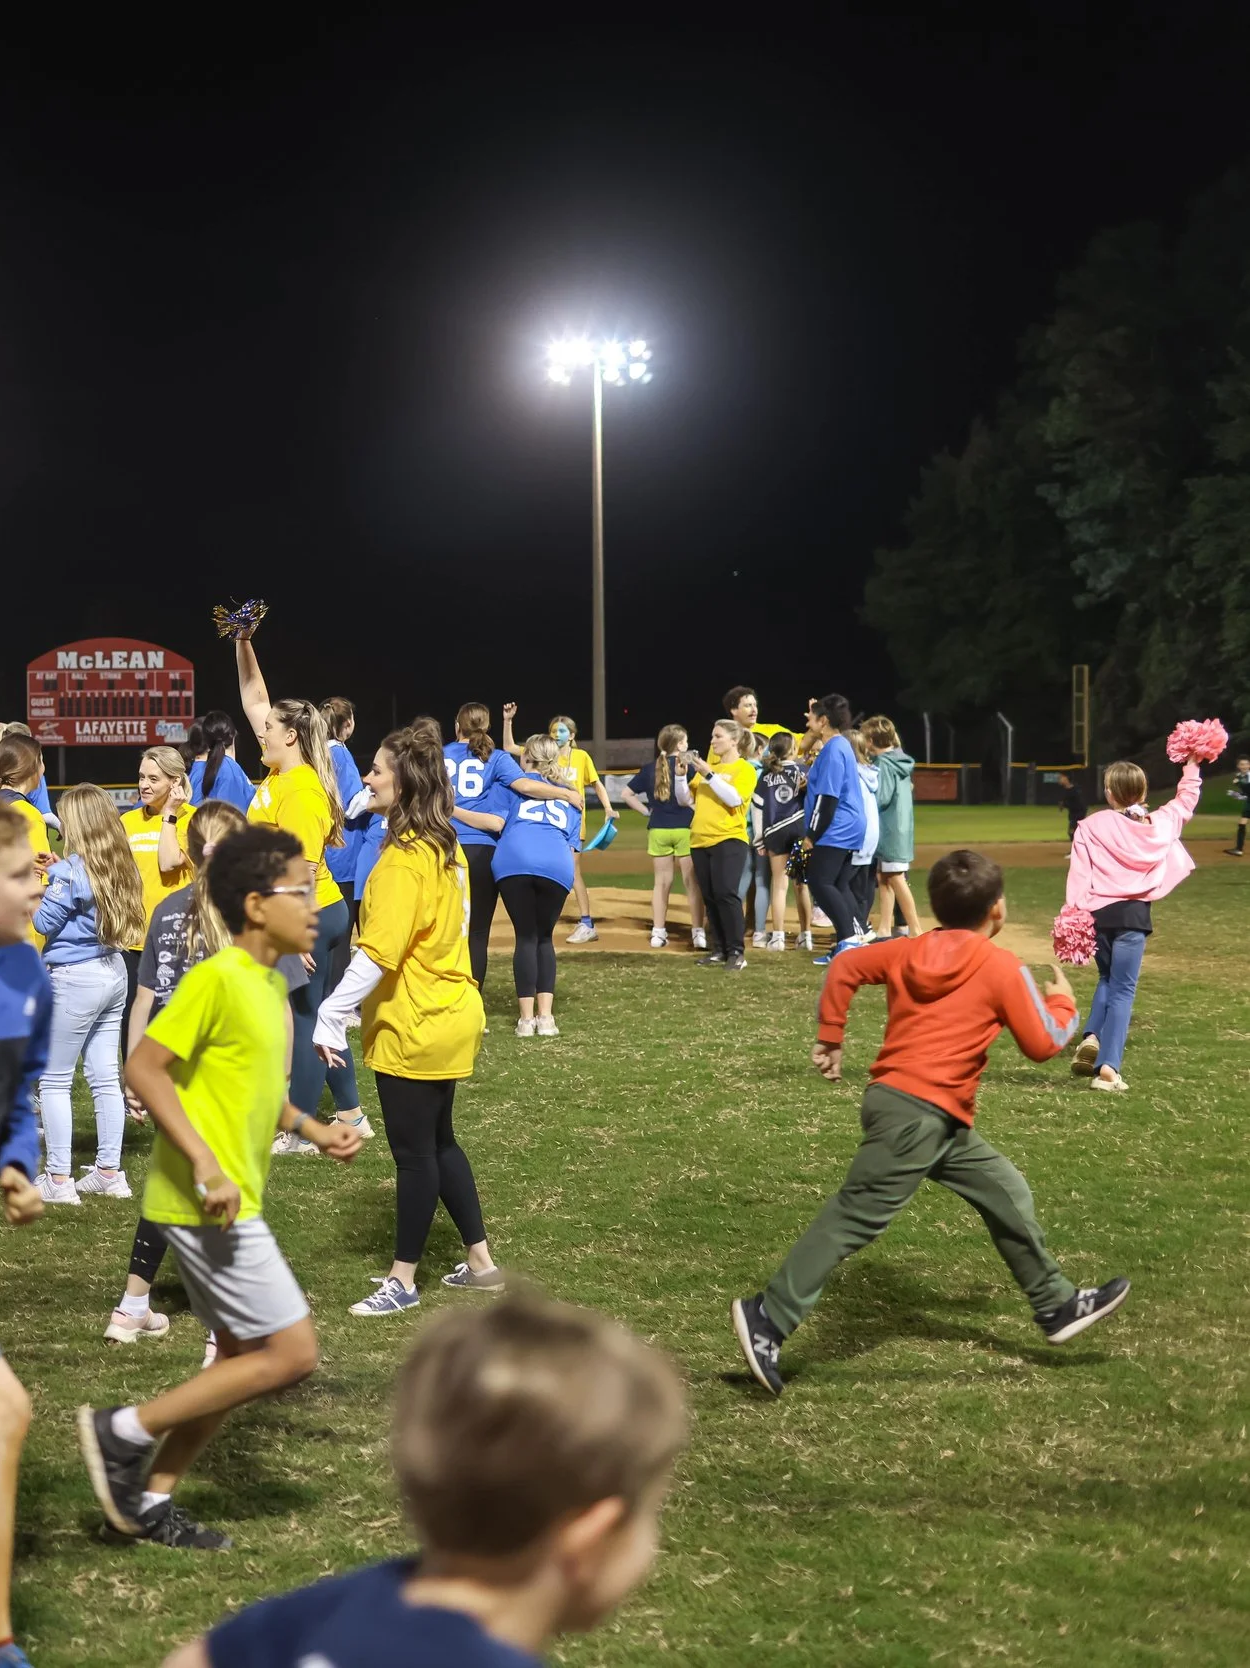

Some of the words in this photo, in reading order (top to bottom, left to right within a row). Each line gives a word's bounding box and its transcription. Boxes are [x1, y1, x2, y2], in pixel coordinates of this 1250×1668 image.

[57, 651, 164, 669] McLEAN
[31, 698, 54, 707] GUEST
[75, 721, 147, 735] LAFAYETTE
[76, 735, 102, 743] FEDERAL
[103, 735, 125, 743] CREDIT
[126, 735, 147, 743] UNION
[518, 800, 570, 829] 25
